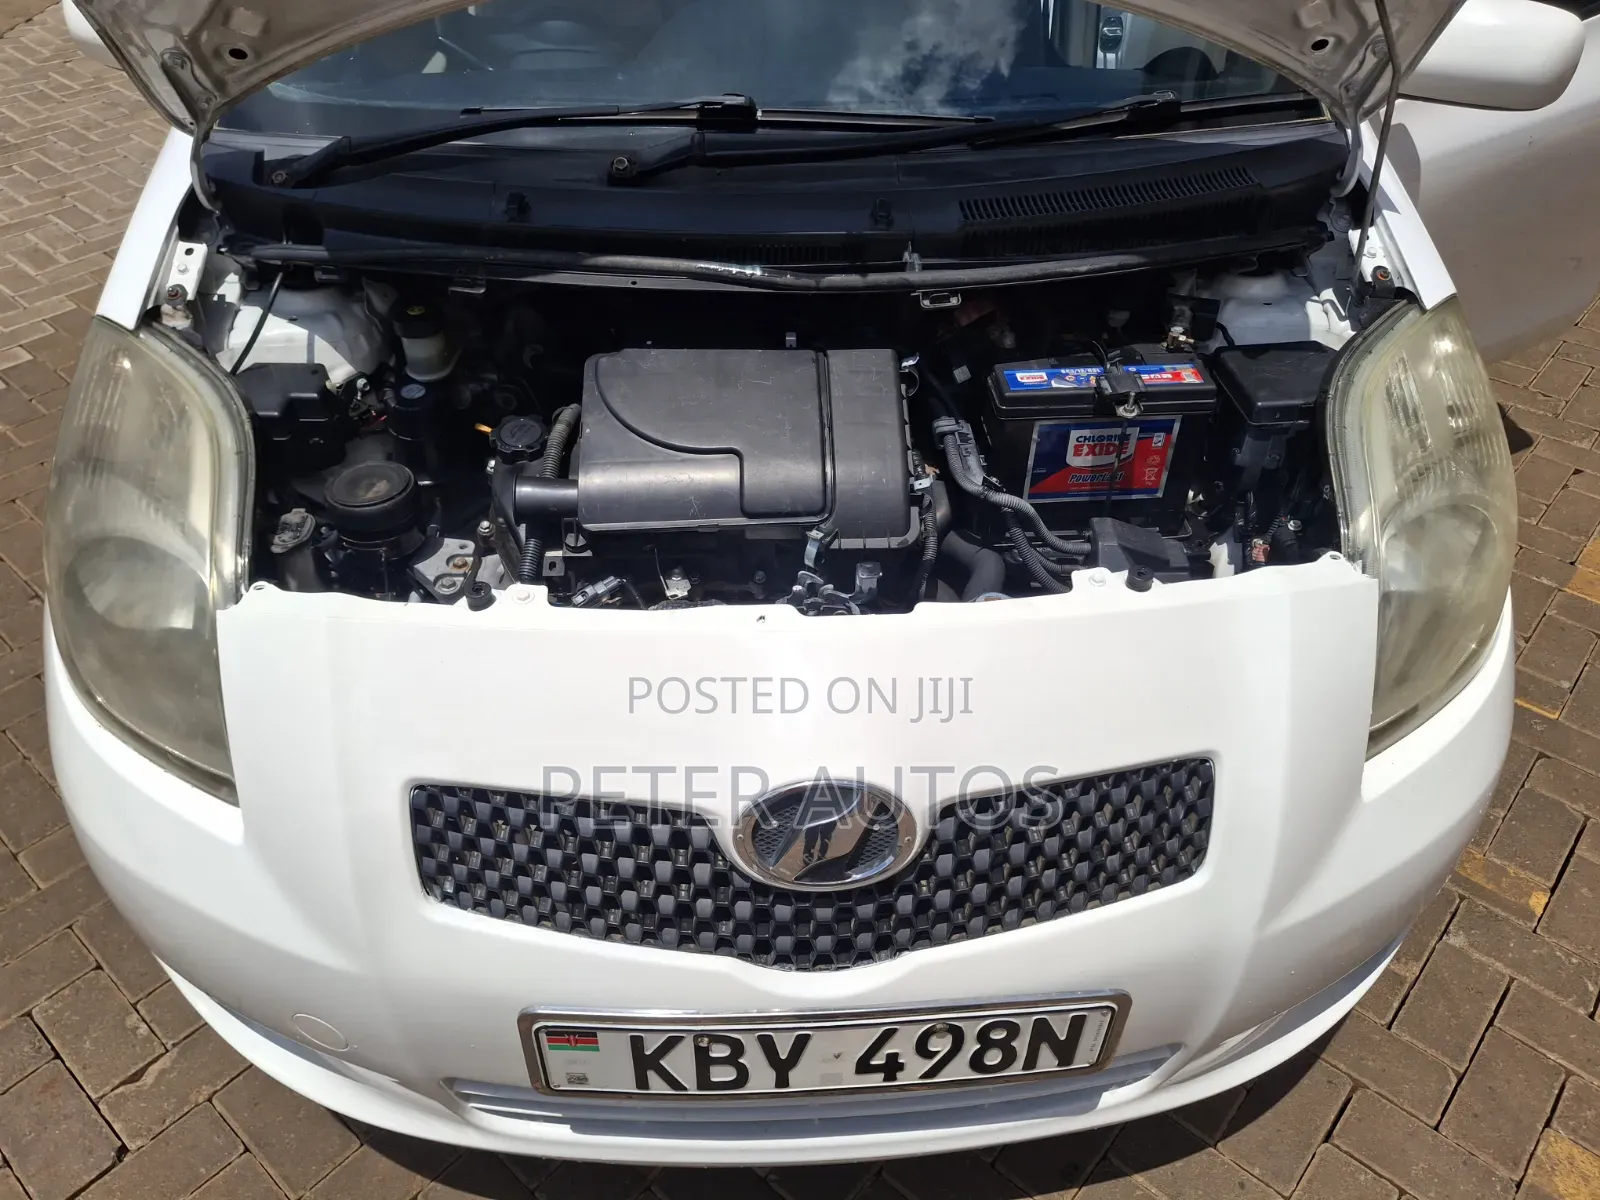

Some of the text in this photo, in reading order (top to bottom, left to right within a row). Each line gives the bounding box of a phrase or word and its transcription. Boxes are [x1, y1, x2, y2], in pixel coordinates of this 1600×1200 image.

[1072, 441, 1130, 457] EXIDE
[629, 1032, 812, 1091] KBY
[854, 1014, 1088, 1082] 498N
